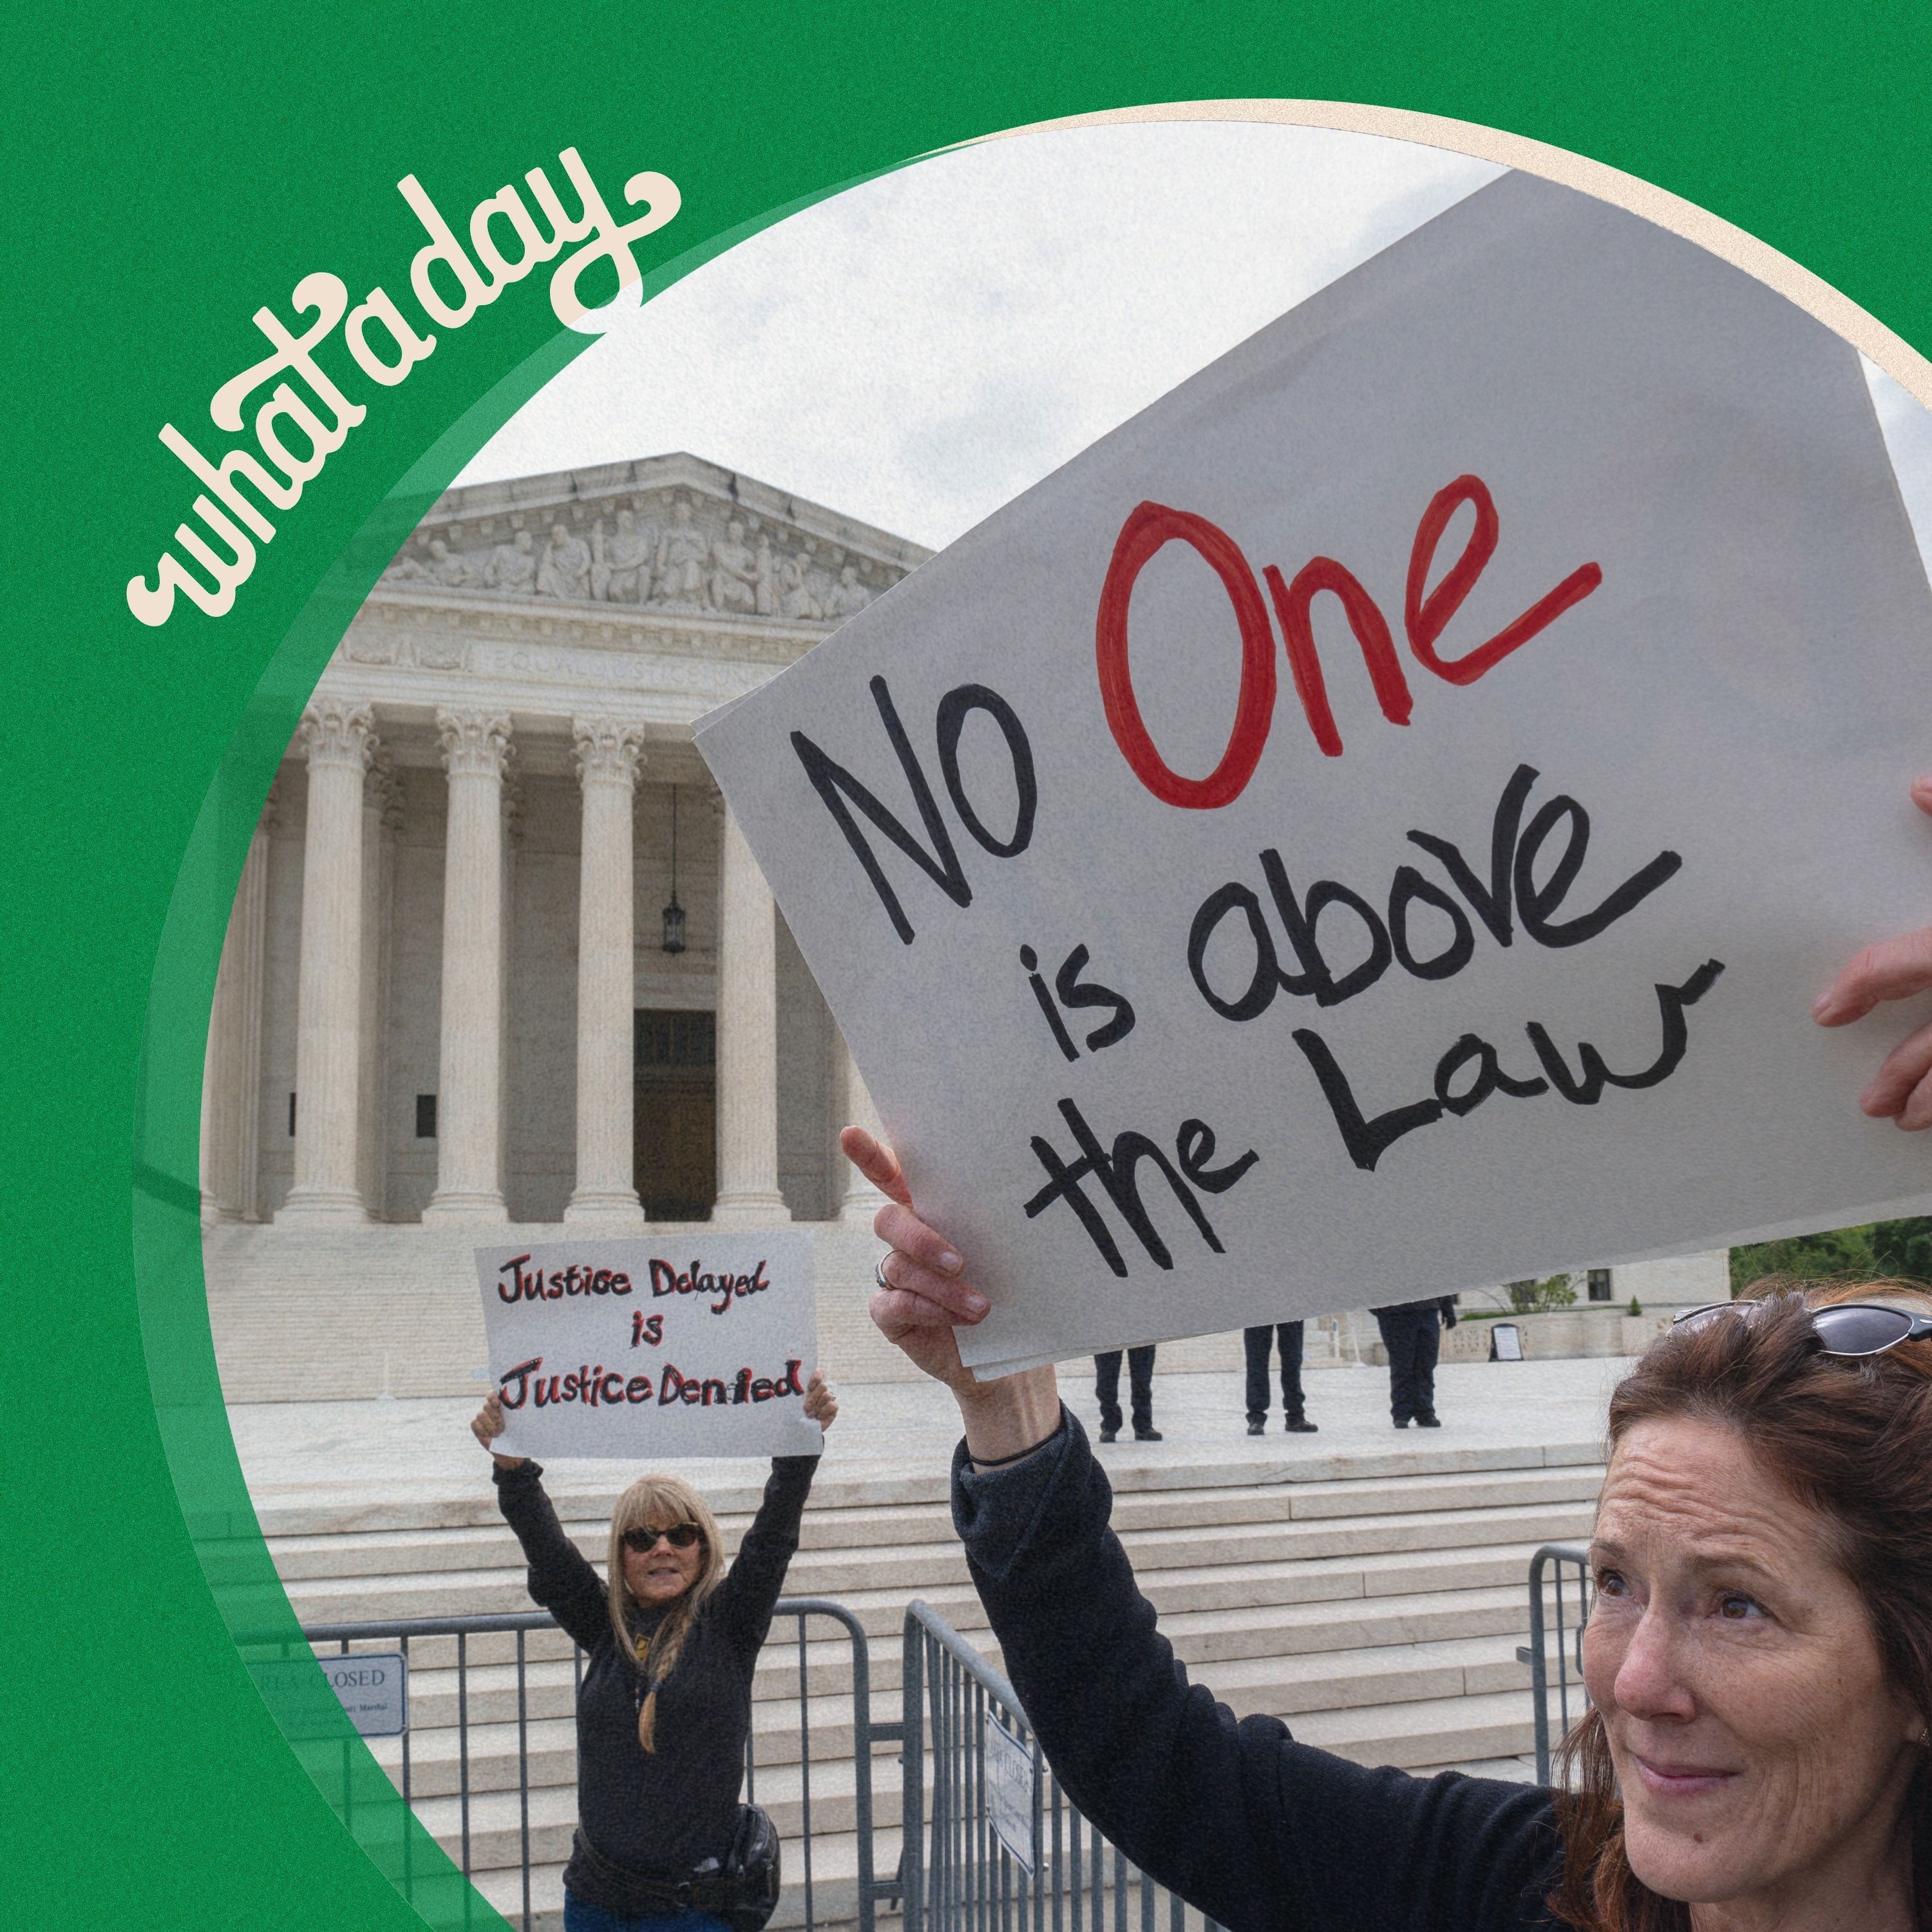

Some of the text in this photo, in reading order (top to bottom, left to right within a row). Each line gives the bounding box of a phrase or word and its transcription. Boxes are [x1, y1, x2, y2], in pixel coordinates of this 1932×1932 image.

[1097, 476, 1601, 809] One
[1021, 764, 1681, 1062] is above
[1024, 959, 1725, 1277] the Law
[498, 1253, 770, 1314] Justice Delayed
[630, 1311, 664, 1349] is
[498, 1357, 804, 1410] Justice Denied
